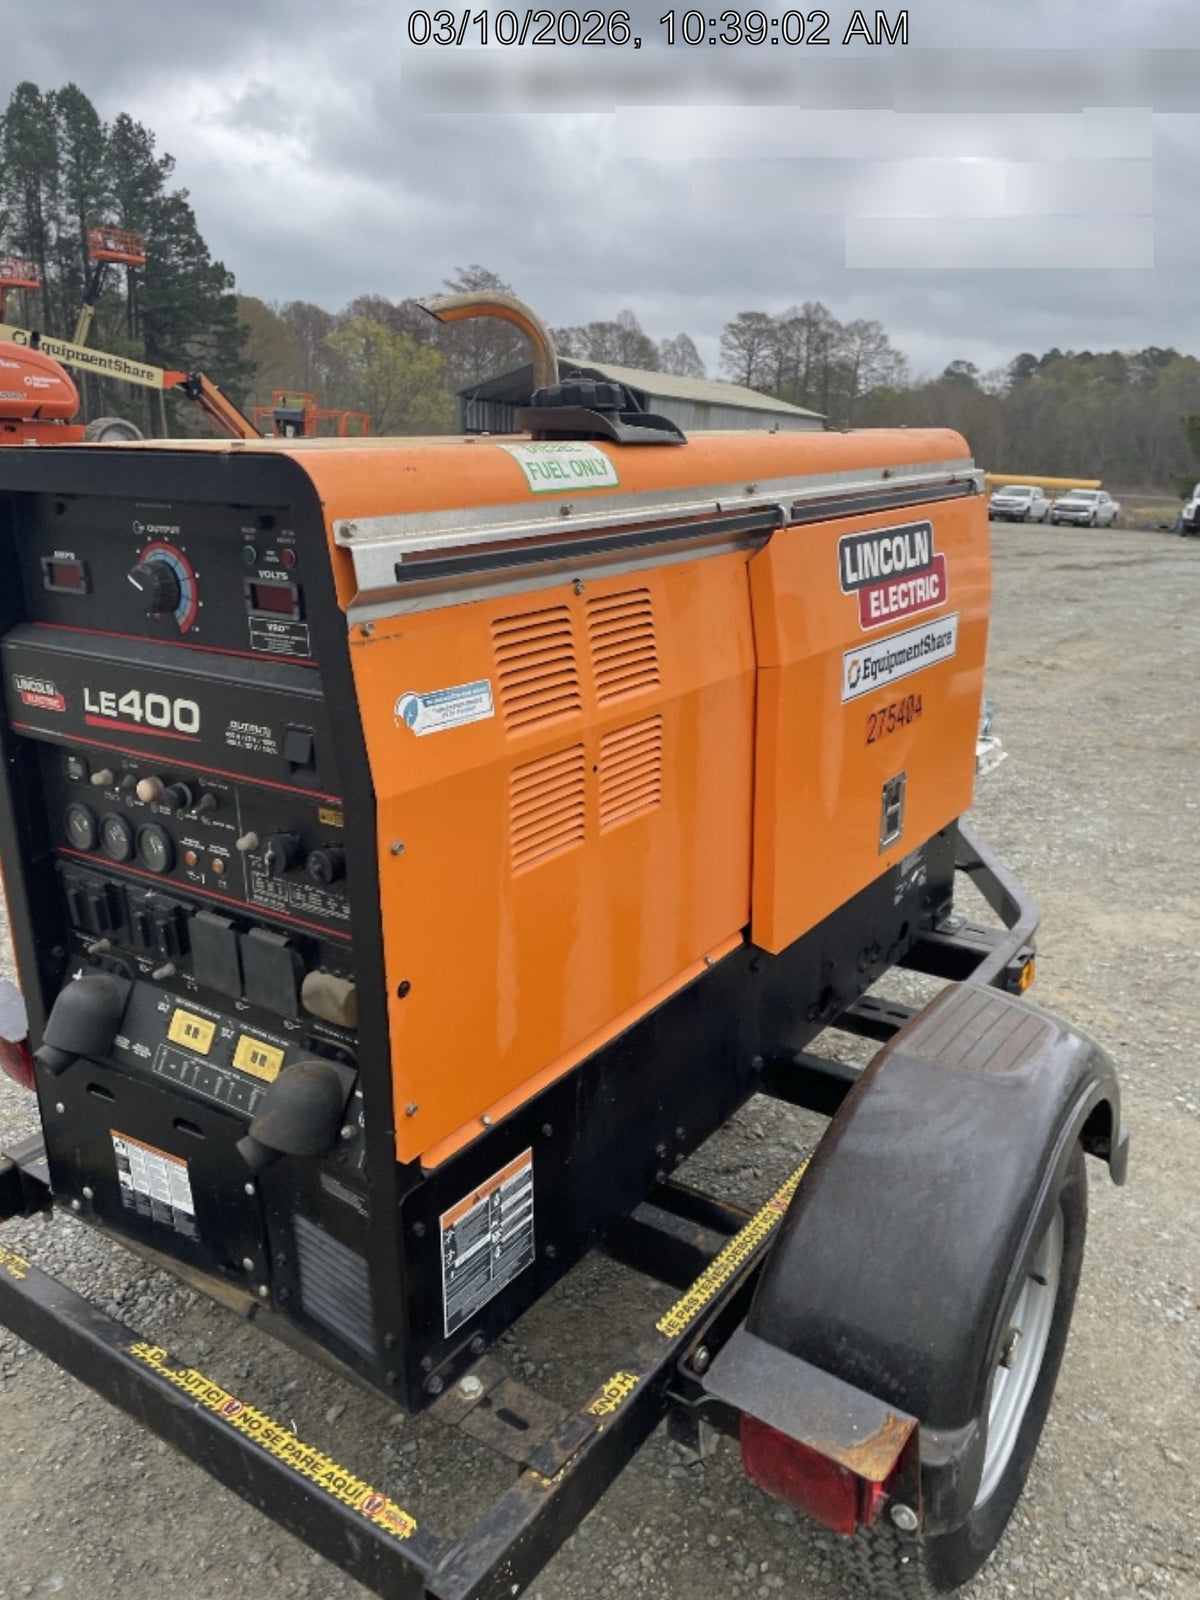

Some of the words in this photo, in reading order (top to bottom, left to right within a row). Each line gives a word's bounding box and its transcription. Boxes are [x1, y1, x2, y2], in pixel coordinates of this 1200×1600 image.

[39, 341, 155, 382] quipmentShare
[525, 460, 571, 480] FUEL
[569, 458, 610, 478] ONLY
[257, 569, 289, 581] VOLTS
[844, 530, 930, 584] LINCOLN
[869, 573, 940, 619] ELECTRIC
[862, 629, 953, 682] EquipmentShare
[83, 686, 201, 735] LE400
[675, 1296, 699, 1320] PAS
[725, 1222, 766, 1266] DEBOUT
[202, 1384, 225, 1404] ICI
[238, 1412, 263, 1431] NO
[260, 1427, 286, 1447] SE
[282, 1442, 325, 1474] PARE
